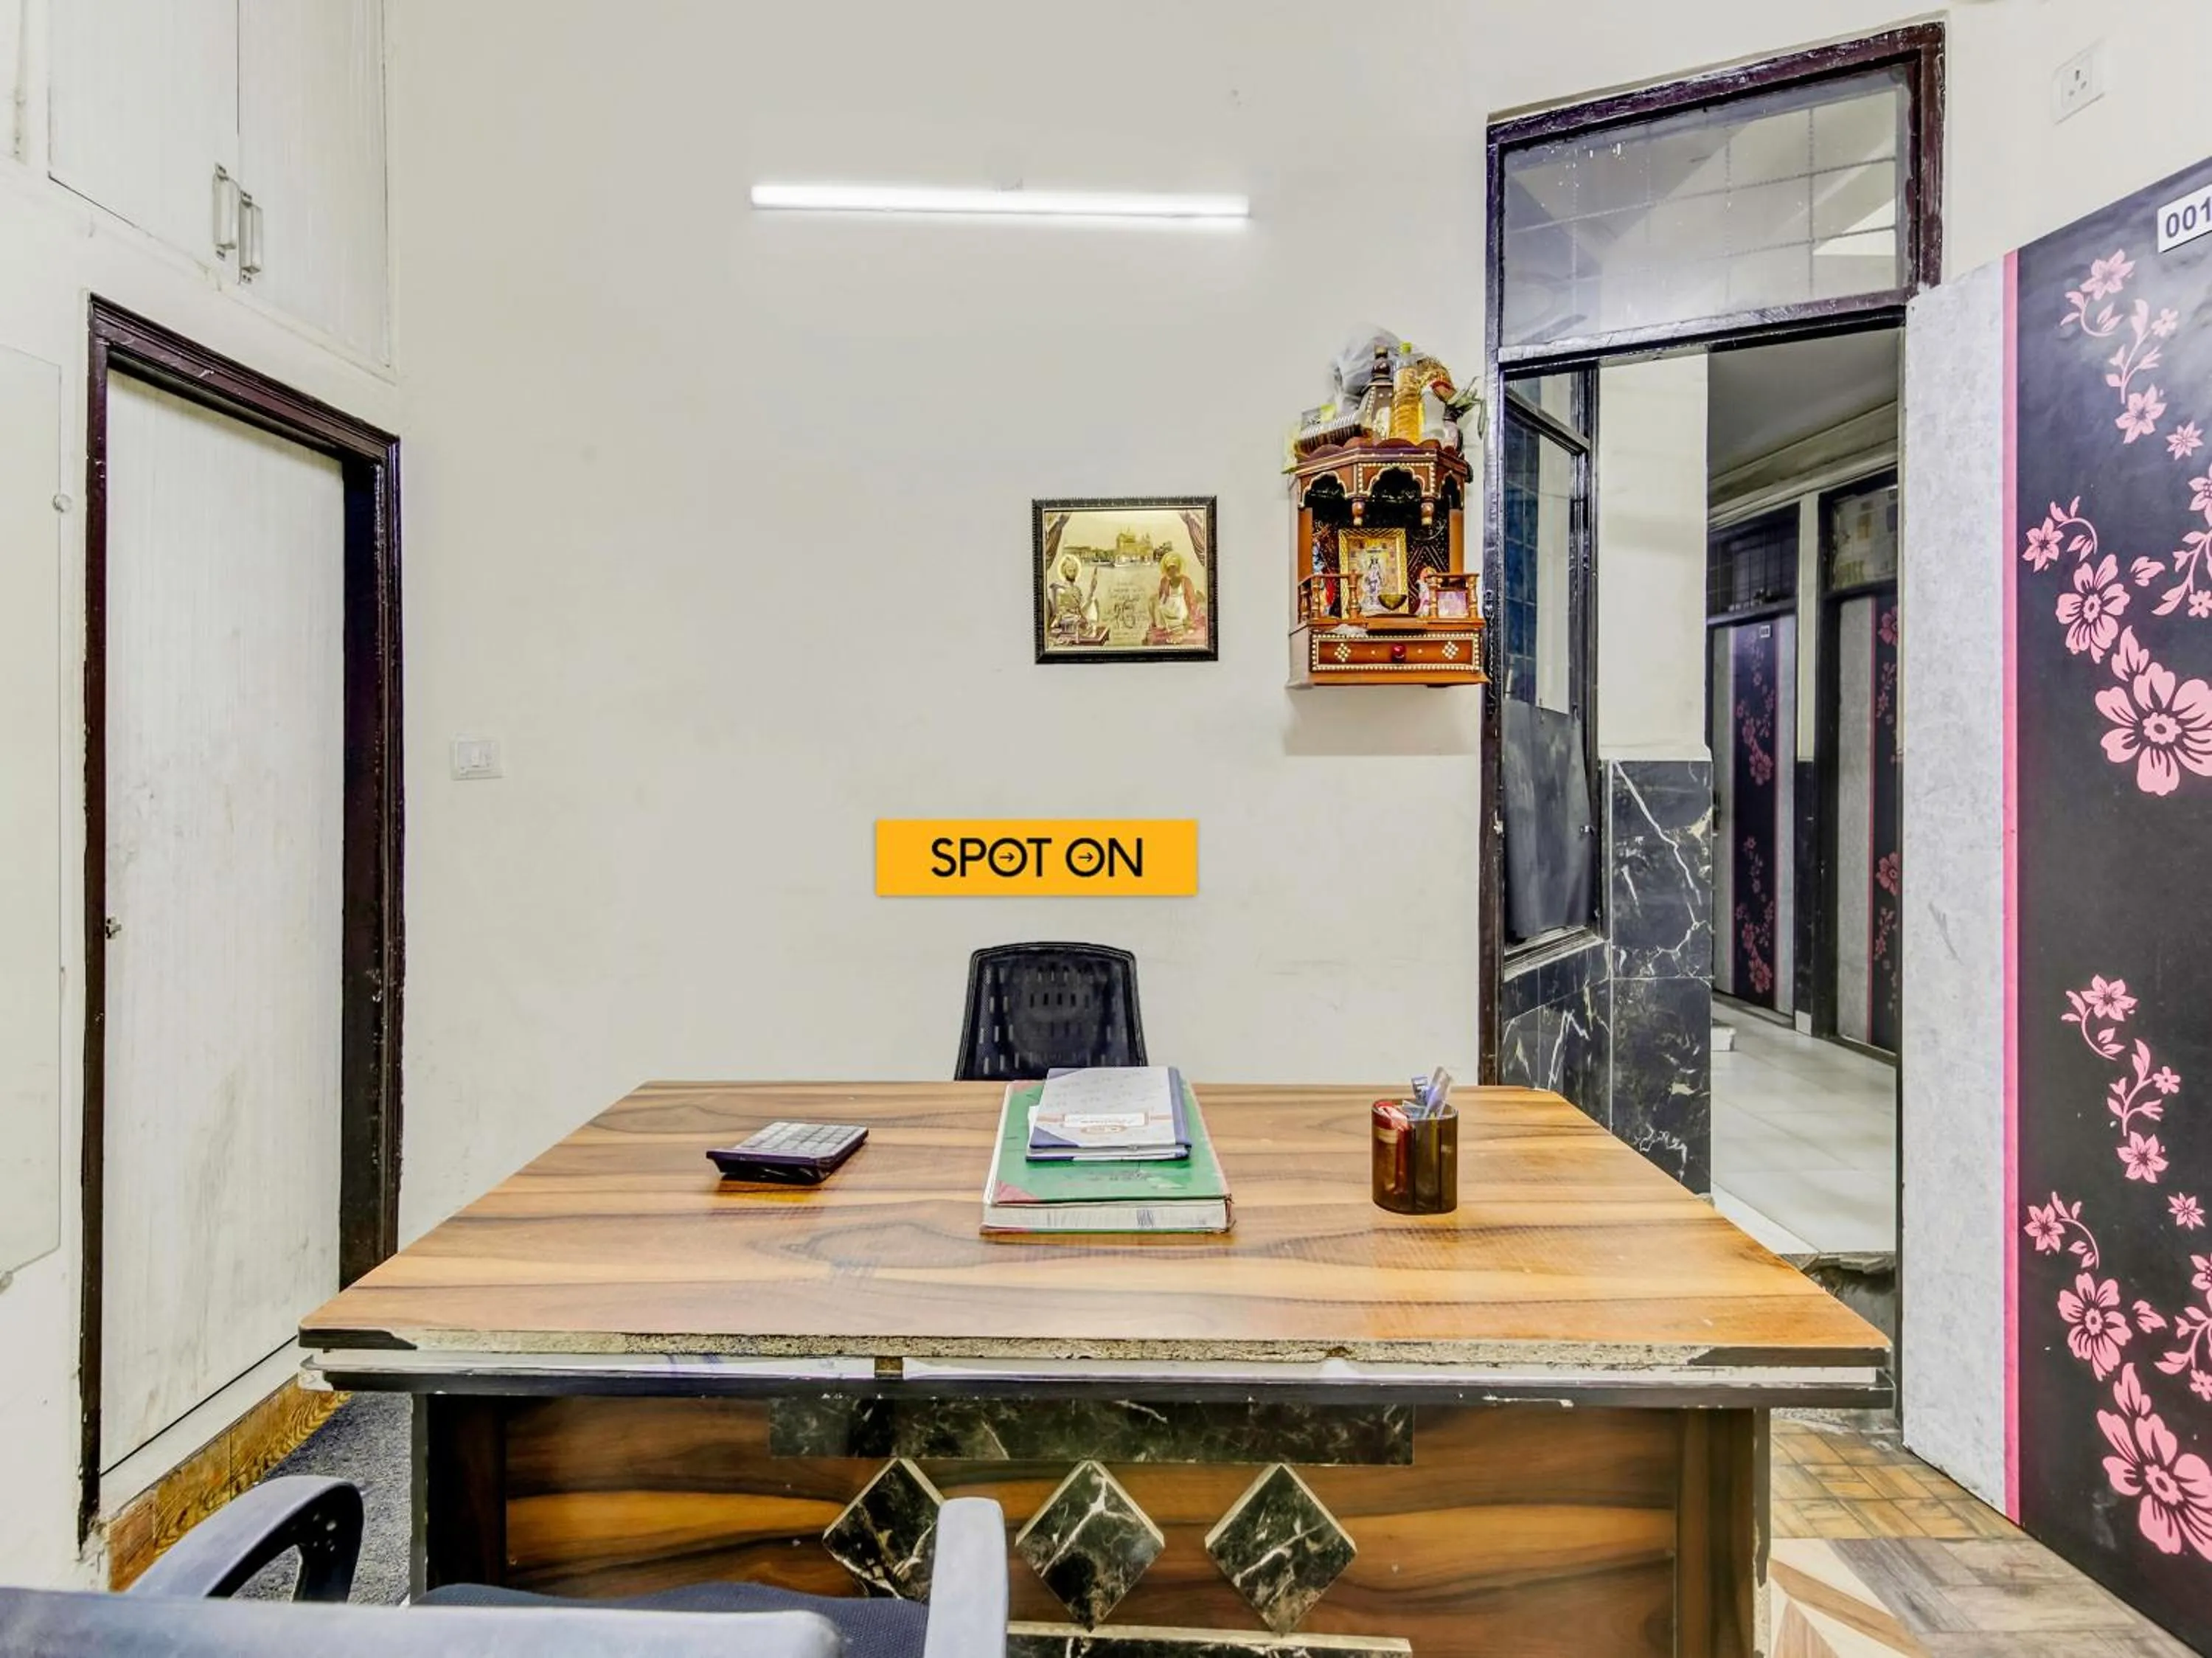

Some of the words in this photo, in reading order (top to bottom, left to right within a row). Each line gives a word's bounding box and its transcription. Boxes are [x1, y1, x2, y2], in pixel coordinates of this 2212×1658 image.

[2166, 197, 2211, 237] 001
[931, 837, 1052, 877] SPOT
[1065, 837, 1143, 877] ON
